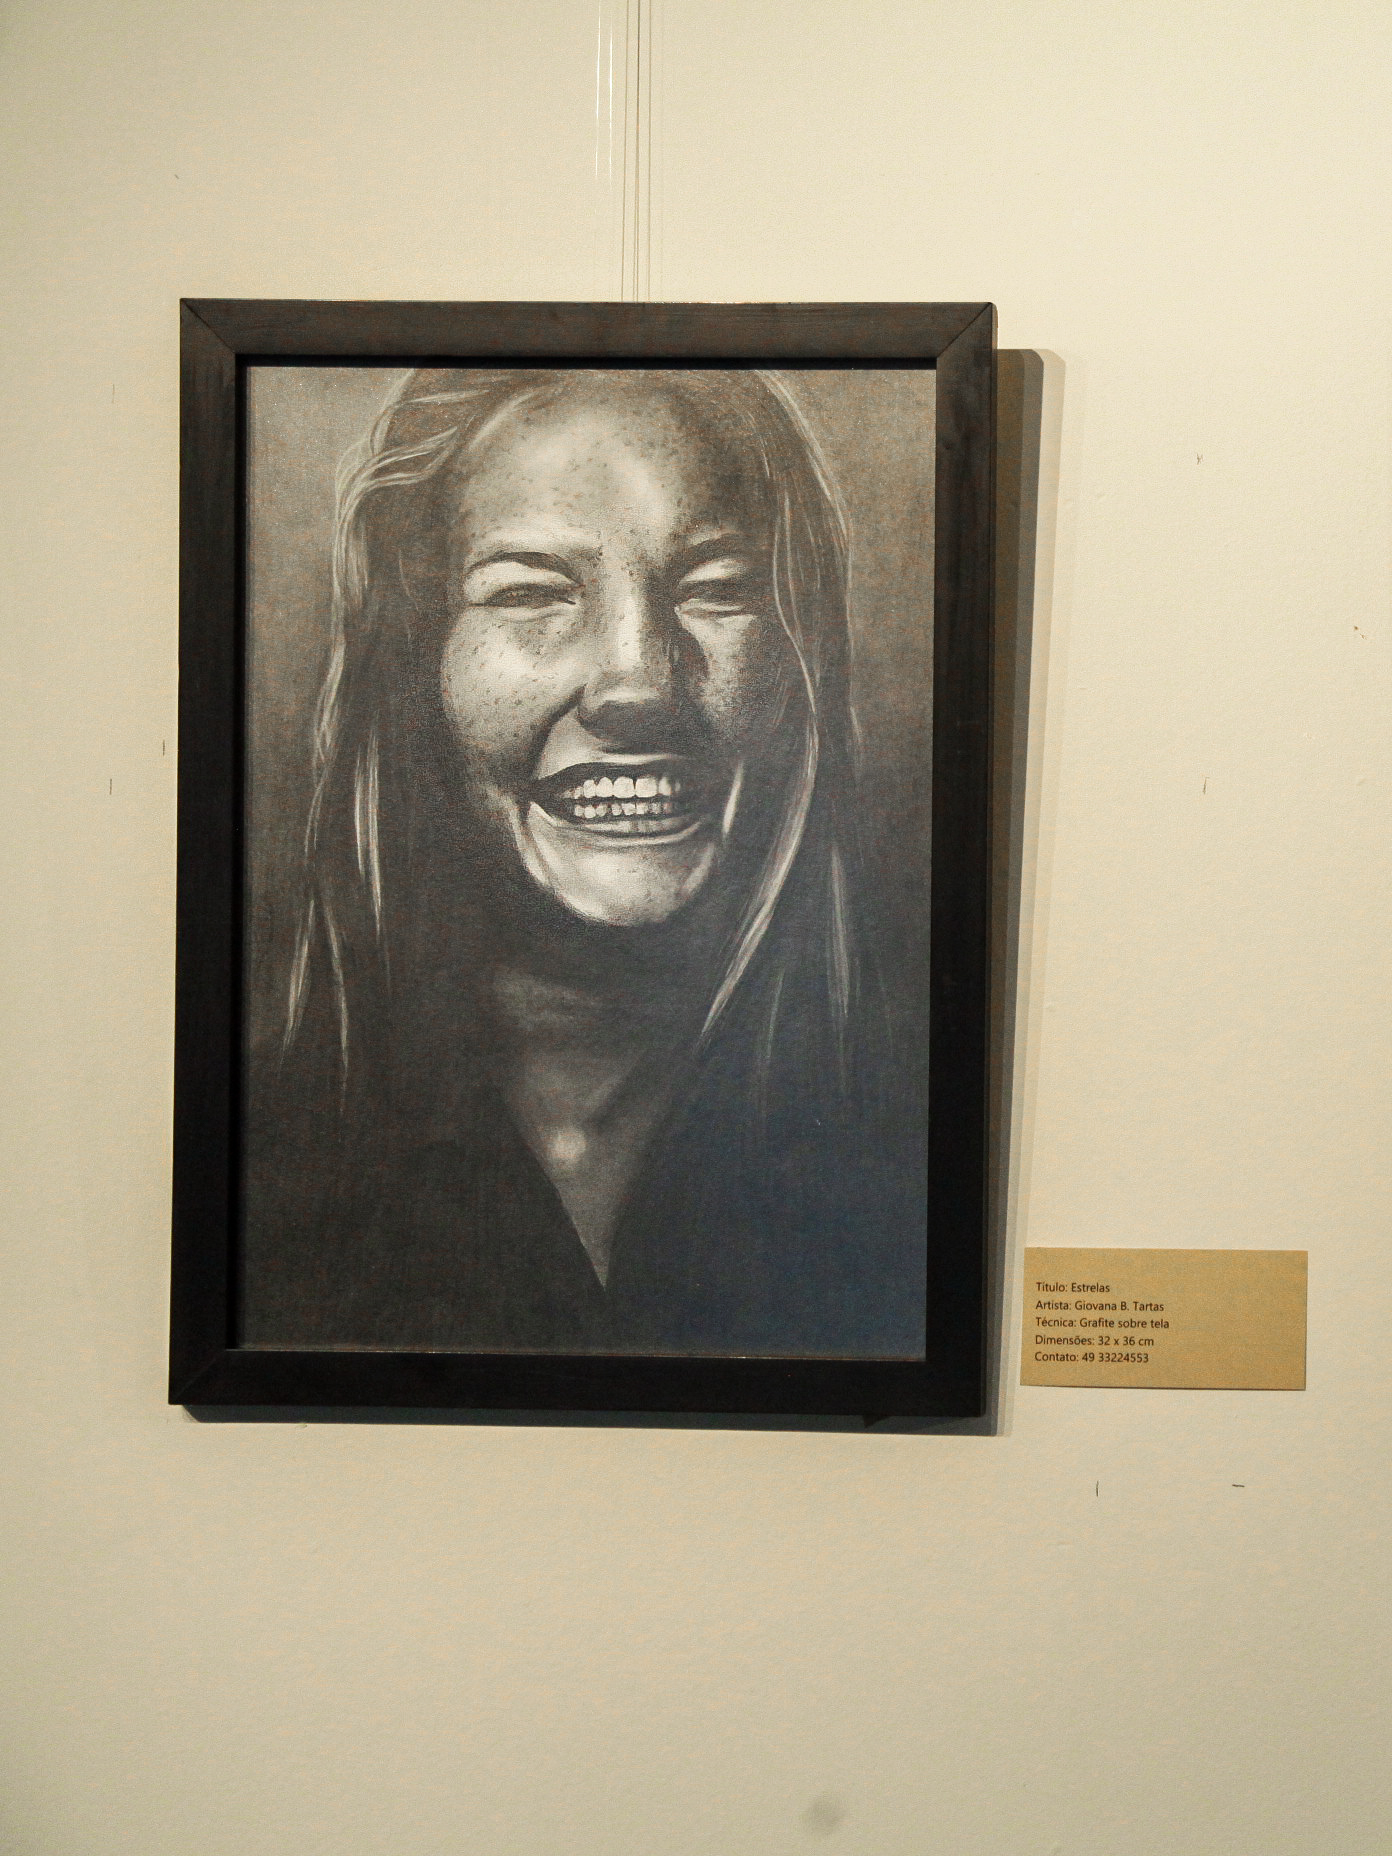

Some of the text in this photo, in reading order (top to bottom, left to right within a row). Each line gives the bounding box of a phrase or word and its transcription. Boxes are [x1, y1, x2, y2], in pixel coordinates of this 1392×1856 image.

[1036, 1281, 1110, 1293] Título: Estrelas
[1035, 1300, 1165, 1312] Artista: Giovana B. Tartas
[1036, 1316, 1170, 1329] Técnica: Grafite sobre tela
[1035, 1335, 1155, 1347] Dimensões: 32 x 36 cm
[1034, 1351, 1150, 1363] Contato: 49 33224553
